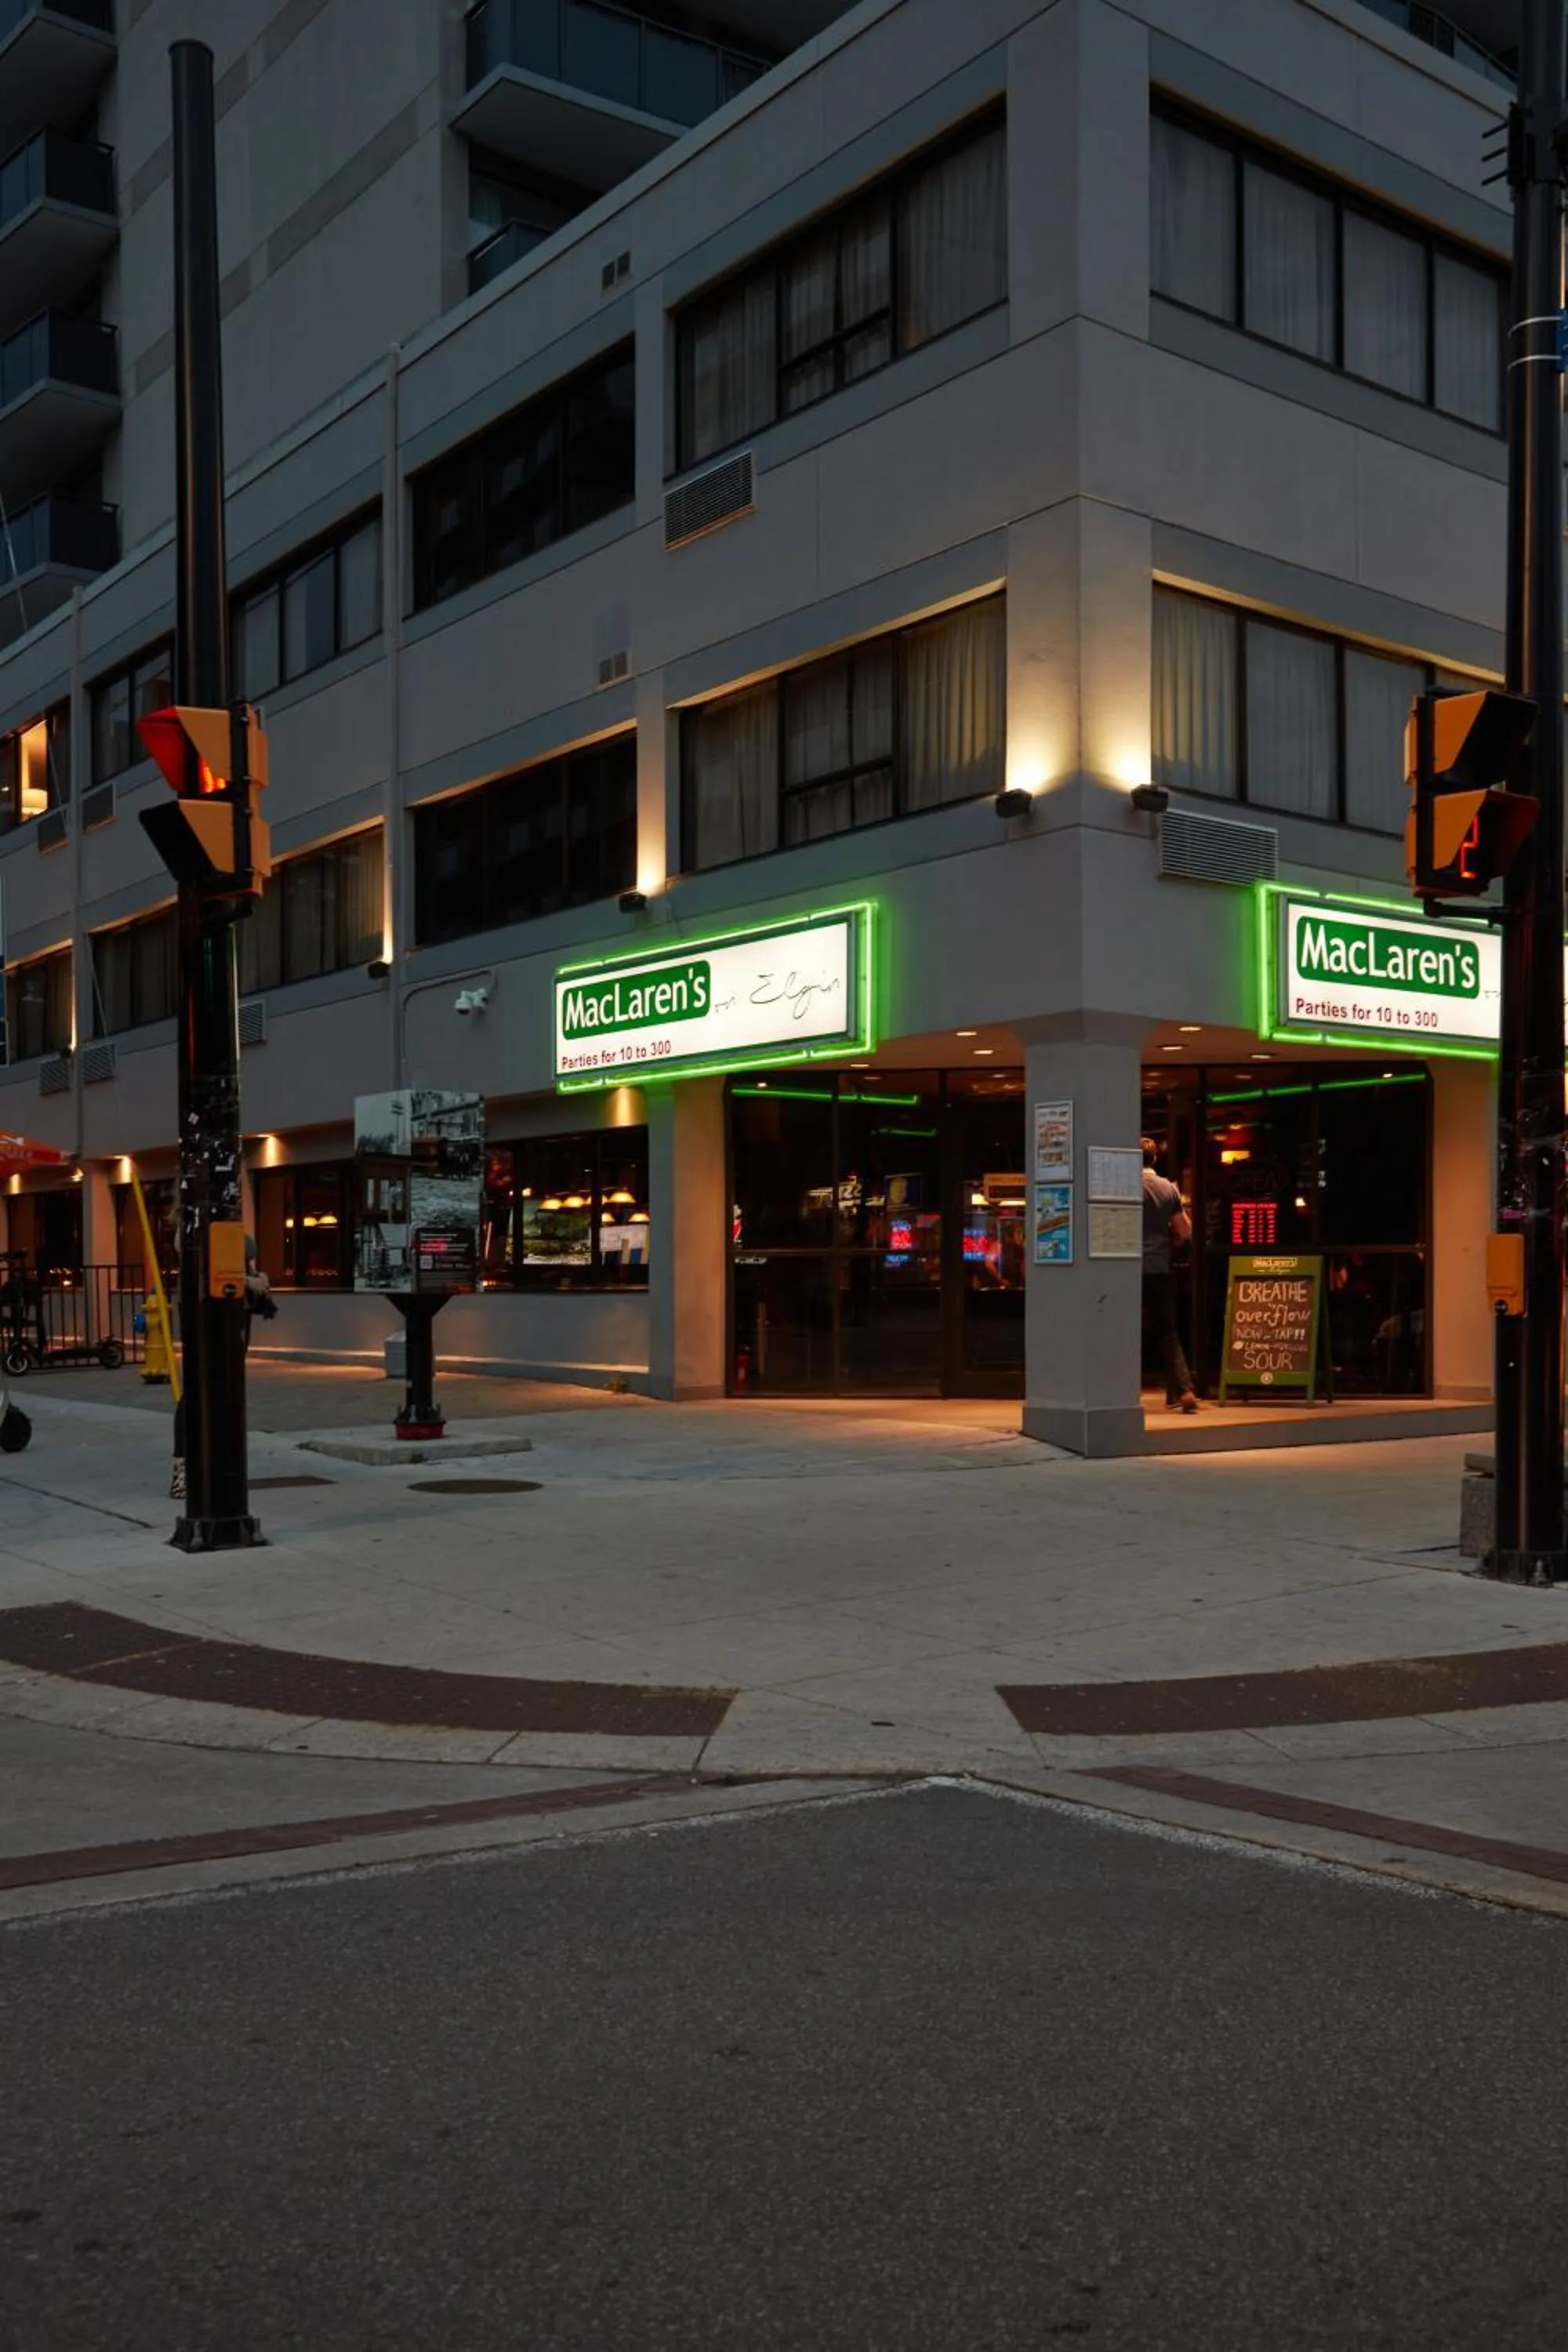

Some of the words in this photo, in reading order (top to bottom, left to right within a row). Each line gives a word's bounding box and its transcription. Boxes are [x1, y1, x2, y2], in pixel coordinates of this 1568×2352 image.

[1301, 922, 1475, 989] MacLaren's
[564, 967, 707, 1032] MacLaren's
[750, 969, 841, 1020] Elgin
[1295, 997, 1347, 1019] Parties
[1352, 1003, 1371, 1020] for
[1377, 1006, 1392, 1022] 10
[1396, 1009, 1410, 1025] to
[1414, 1010, 1439, 1028] 300
[561, 1052, 598, 1070] Parties
[601, 1048, 616, 1064] for
[620, 1044, 634, 1061] 10
[636, 1044, 648, 1058] to
[650, 1040, 672, 1056] 300
[1238, 1280, 1308, 1303] BREATHE
[1236, 1304, 1312, 1327] overflow
[1243, 1351, 1294, 1370] SOUR
